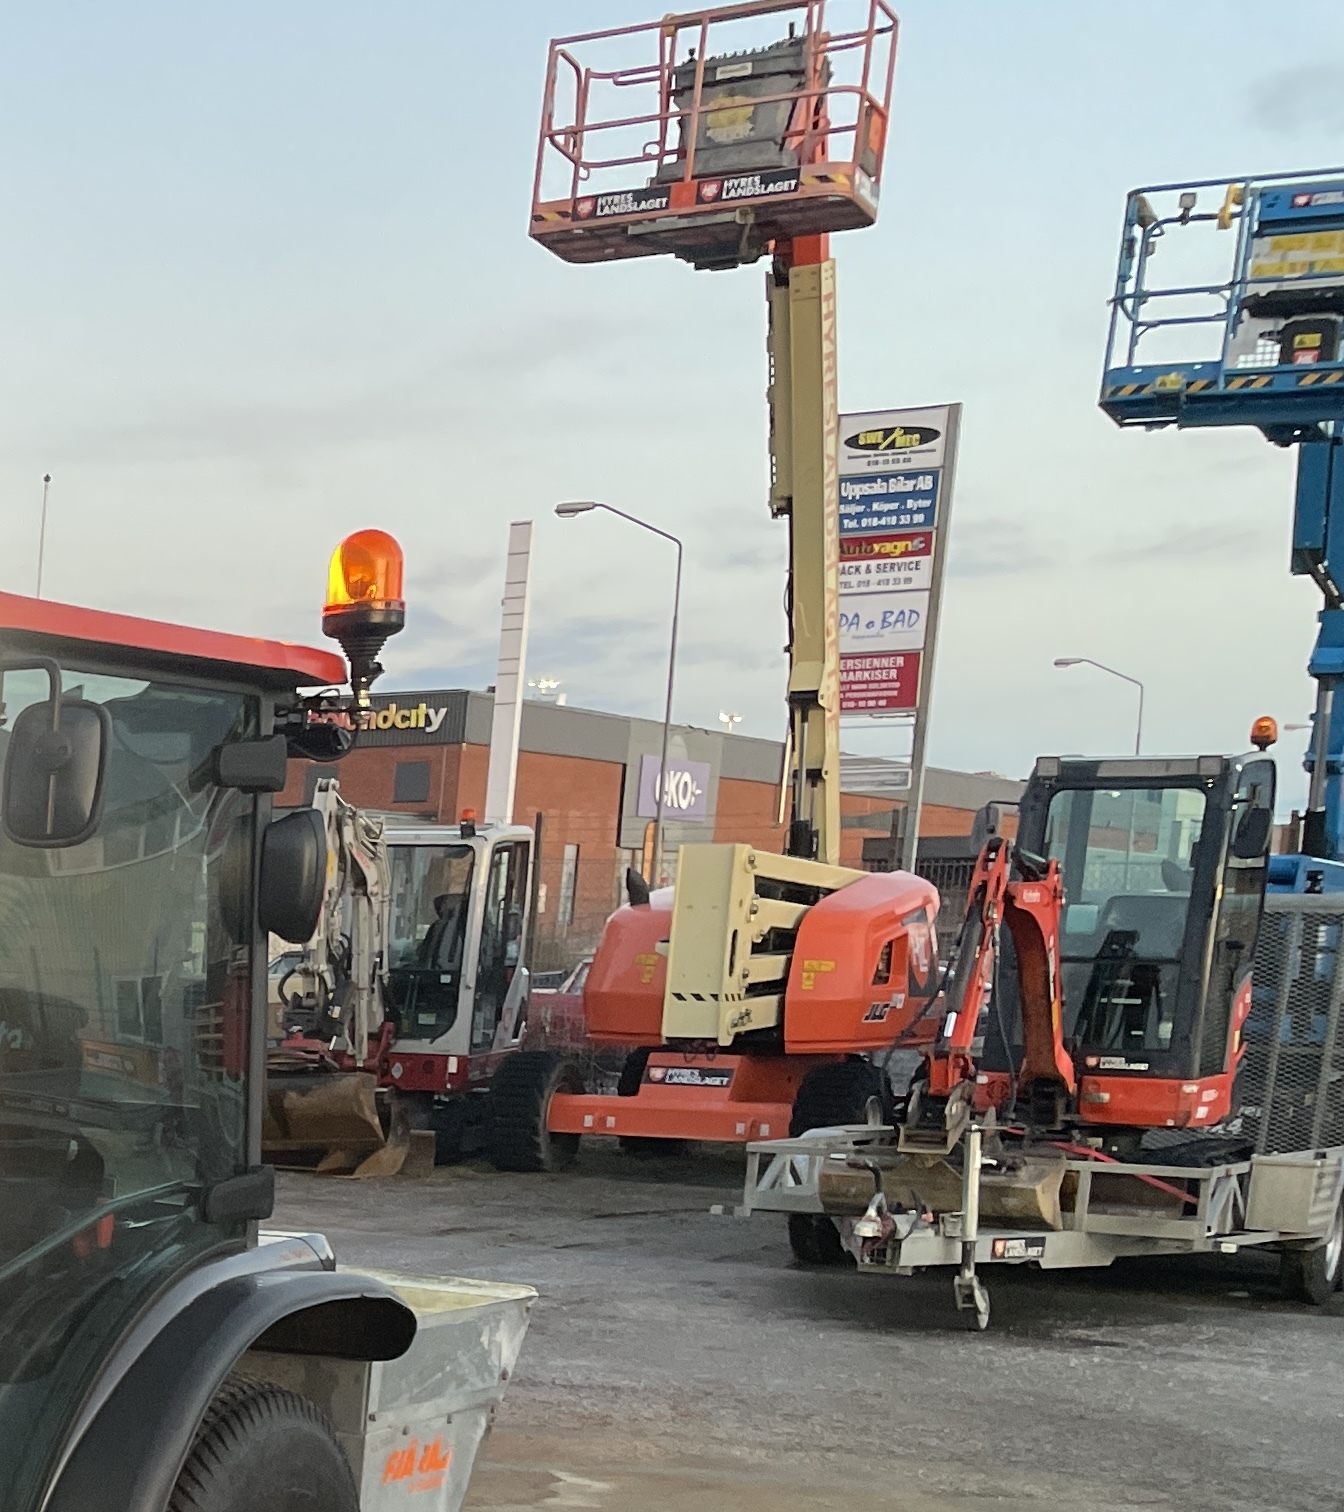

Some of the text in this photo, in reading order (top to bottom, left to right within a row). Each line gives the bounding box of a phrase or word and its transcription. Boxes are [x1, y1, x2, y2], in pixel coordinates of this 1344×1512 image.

[721, 179, 798, 200] LANDSLAGET
[723, 176, 761, 190] HYRES
[596, 197, 668, 217] LANDSLAGET
[597, 193, 633, 207] HYRES
[840, 475, 934, 500] Uppsala Bilar AB
[872, 500, 899, 512] Köper
[906, 498, 932, 511] Byter
[899, 514, 911, 525] 33
[875, 560, 922, 574] SERVICE
[879, 608, 921, 630] BAD
[840, 656, 905, 670] ERSIENNER
[840, 669, 898, 682] MARKISER
